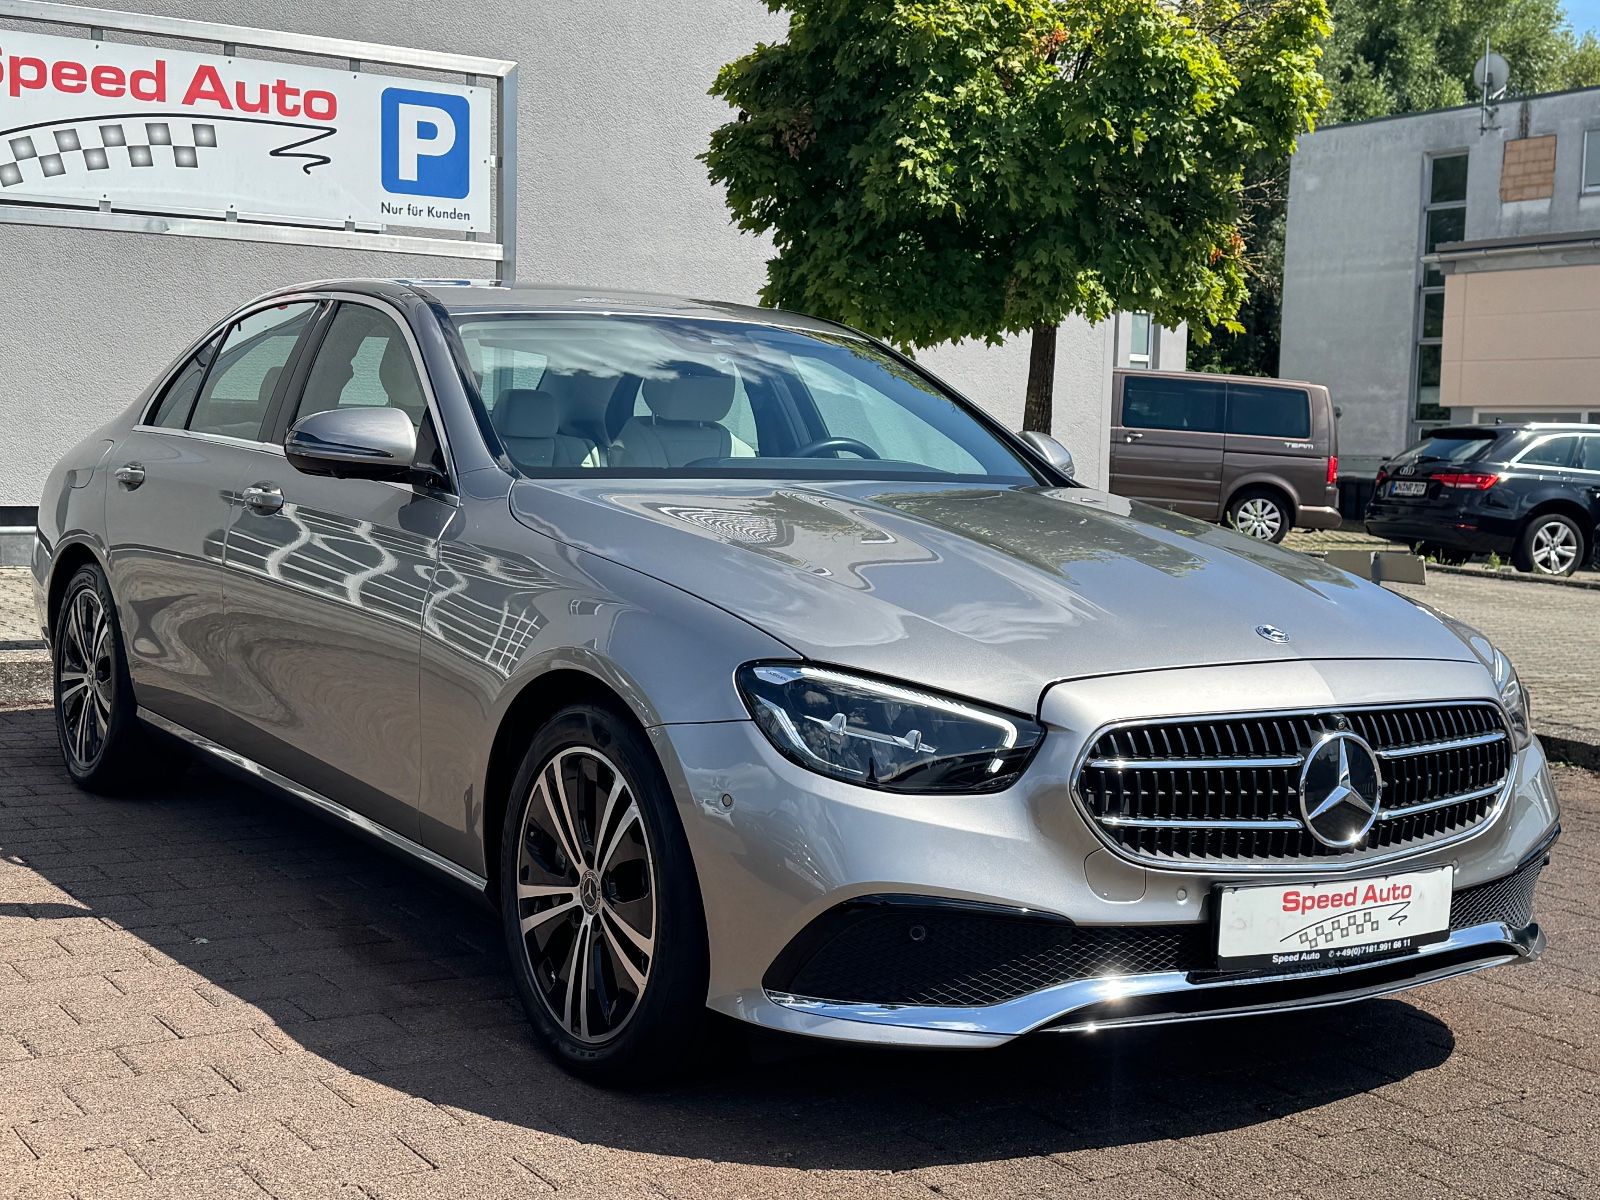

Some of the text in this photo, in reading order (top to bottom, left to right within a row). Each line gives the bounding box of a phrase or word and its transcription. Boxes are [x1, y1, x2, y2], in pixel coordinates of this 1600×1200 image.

[0, 46, 338, 121] peed Auto
[398, 102, 456, 182] P
[381, 201, 471, 221] Nur für Kunden
[1282, 884, 1412, 915] Speed Auto
[1272, 952, 1299, 964] Speed
[1301, 952, 1320, 961] Auto
